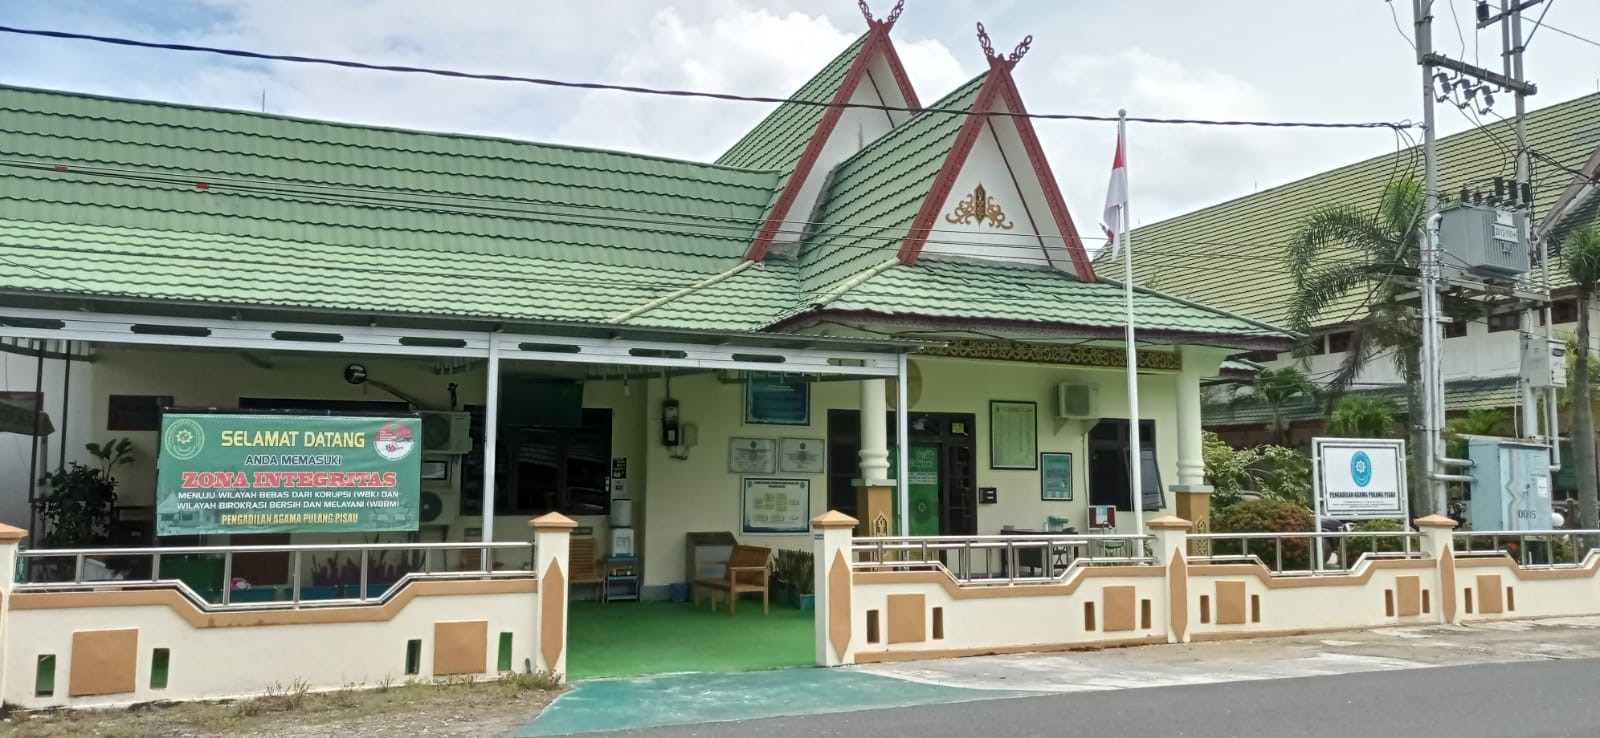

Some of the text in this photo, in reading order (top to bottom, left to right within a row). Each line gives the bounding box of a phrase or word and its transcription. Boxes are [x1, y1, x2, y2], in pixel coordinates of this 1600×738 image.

[221, 430, 299, 447] SELAMAT
[303, 431, 365, 448] DATANG
[244, 454, 342, 466] ANDA MEMASUKI
[182, 471, 397, 489] ZONA INTEGRITAS
[178, 491, 216, 500] MENUJU
[218, 491, 257, 499] WILAYAH
[259, 491, 290, 499] BEBAS
[314, 490, 351, 498] KORUPSI
[353, 490, 379, 498] (WBK)
[381, 490, 399, 498] DAN
[177, 501, 217, 510] WILAYAH
[218, 501, 267, 509] BIROKRASI
[269, 501, 301, 509] BERSIH
[323, 500, 364, 508] MELAYANI
[366, 500, 400, 508] (WBBM)
[222, 512, 358, 525] PENGADILAN AGAMA PULANG PISAU
